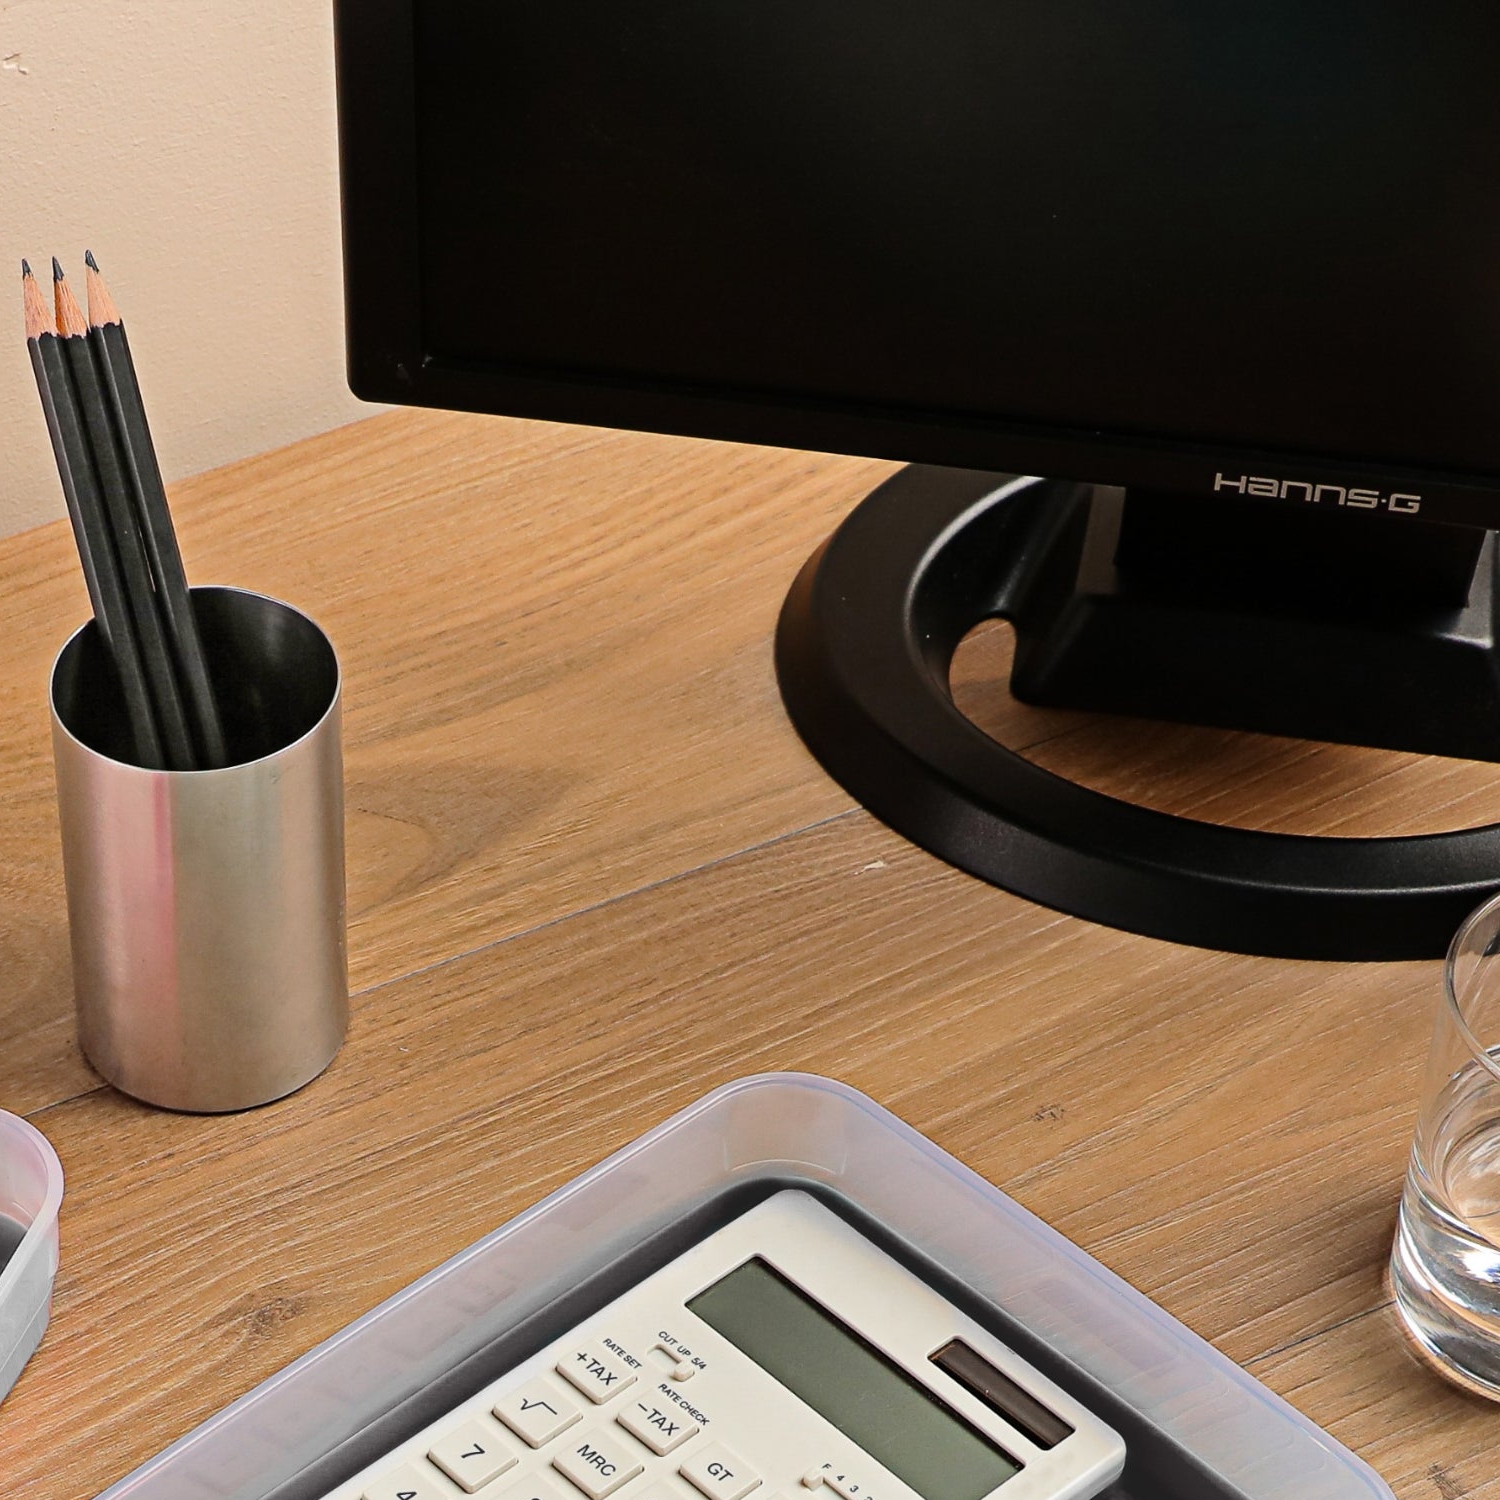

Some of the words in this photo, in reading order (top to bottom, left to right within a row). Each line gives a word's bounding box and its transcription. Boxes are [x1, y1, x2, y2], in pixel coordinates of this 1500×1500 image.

[602, 1337, 627, 1358] RATE
[621, 1352, 643, 1370] SET
[658, 1330, 677, 1347] CUT
[676, 1343, 692, 1359] UP
[691, 1356, 707, 1371] 5/4
[576, 1352, 618, 1387] +TAX
[658, 1383, 682, 1404] RATE
[679, 1399, 710, 1427] CHECK
[461, 1443, 486, 1459] 7
[577, 1444, 617, 1478] MRC
[707, 1462, 734, 1482] GT
[836, 1474, 846, 1483] 4
[849, 1484, 859, 1494] 3
